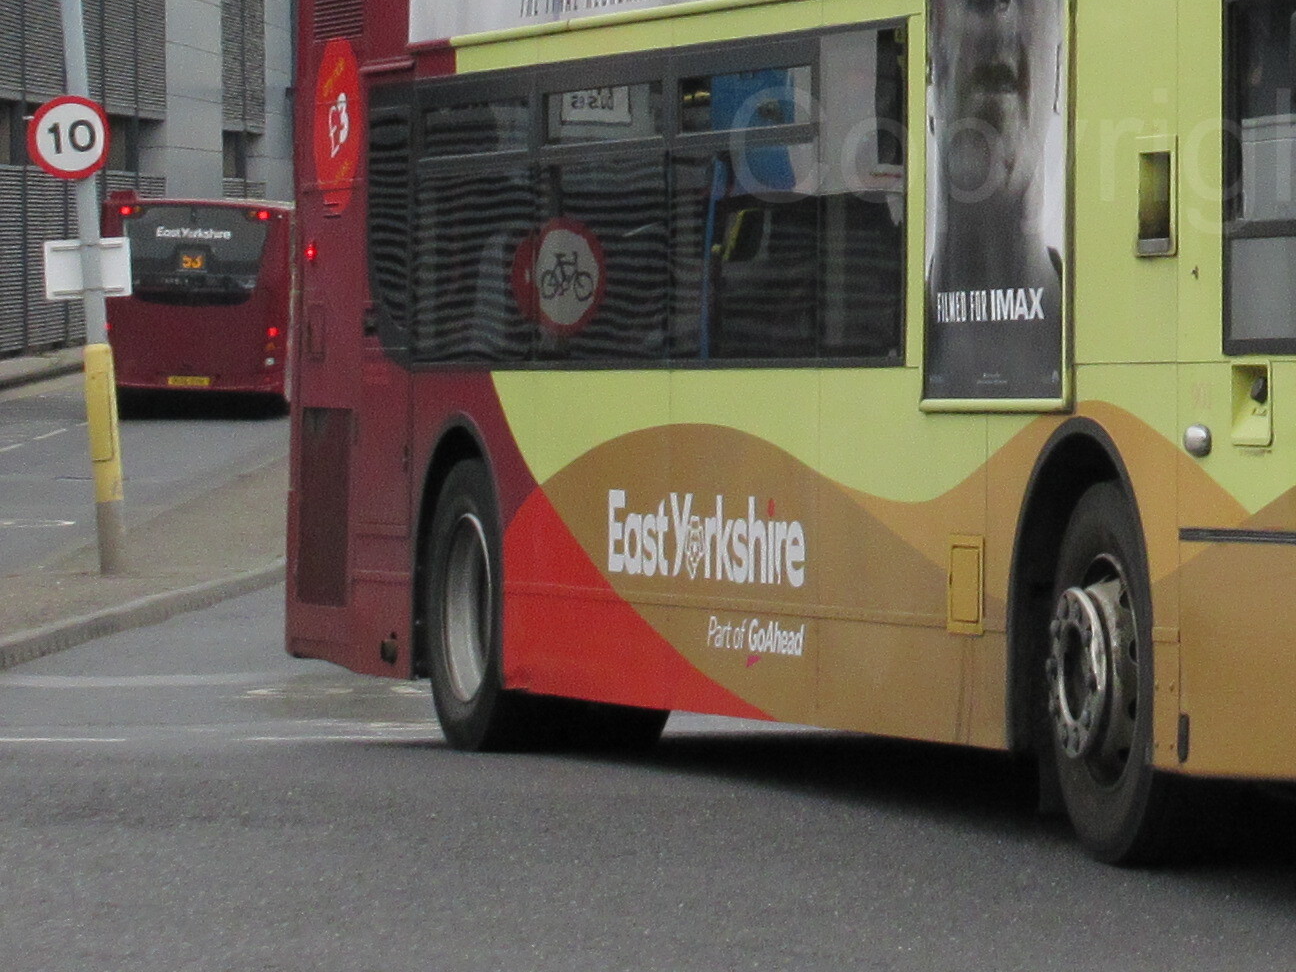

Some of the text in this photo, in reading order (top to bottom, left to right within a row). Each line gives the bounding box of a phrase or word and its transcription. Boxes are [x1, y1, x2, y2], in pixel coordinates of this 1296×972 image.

[46, 119, 97, 155] 10
[328, 92, 349, 158] £3
[937, 287, 1044, 323] FILMED FOR IMAX
[608, 489, 668, 577] East
[707, 616, 805, 656] Part of GoAhead
